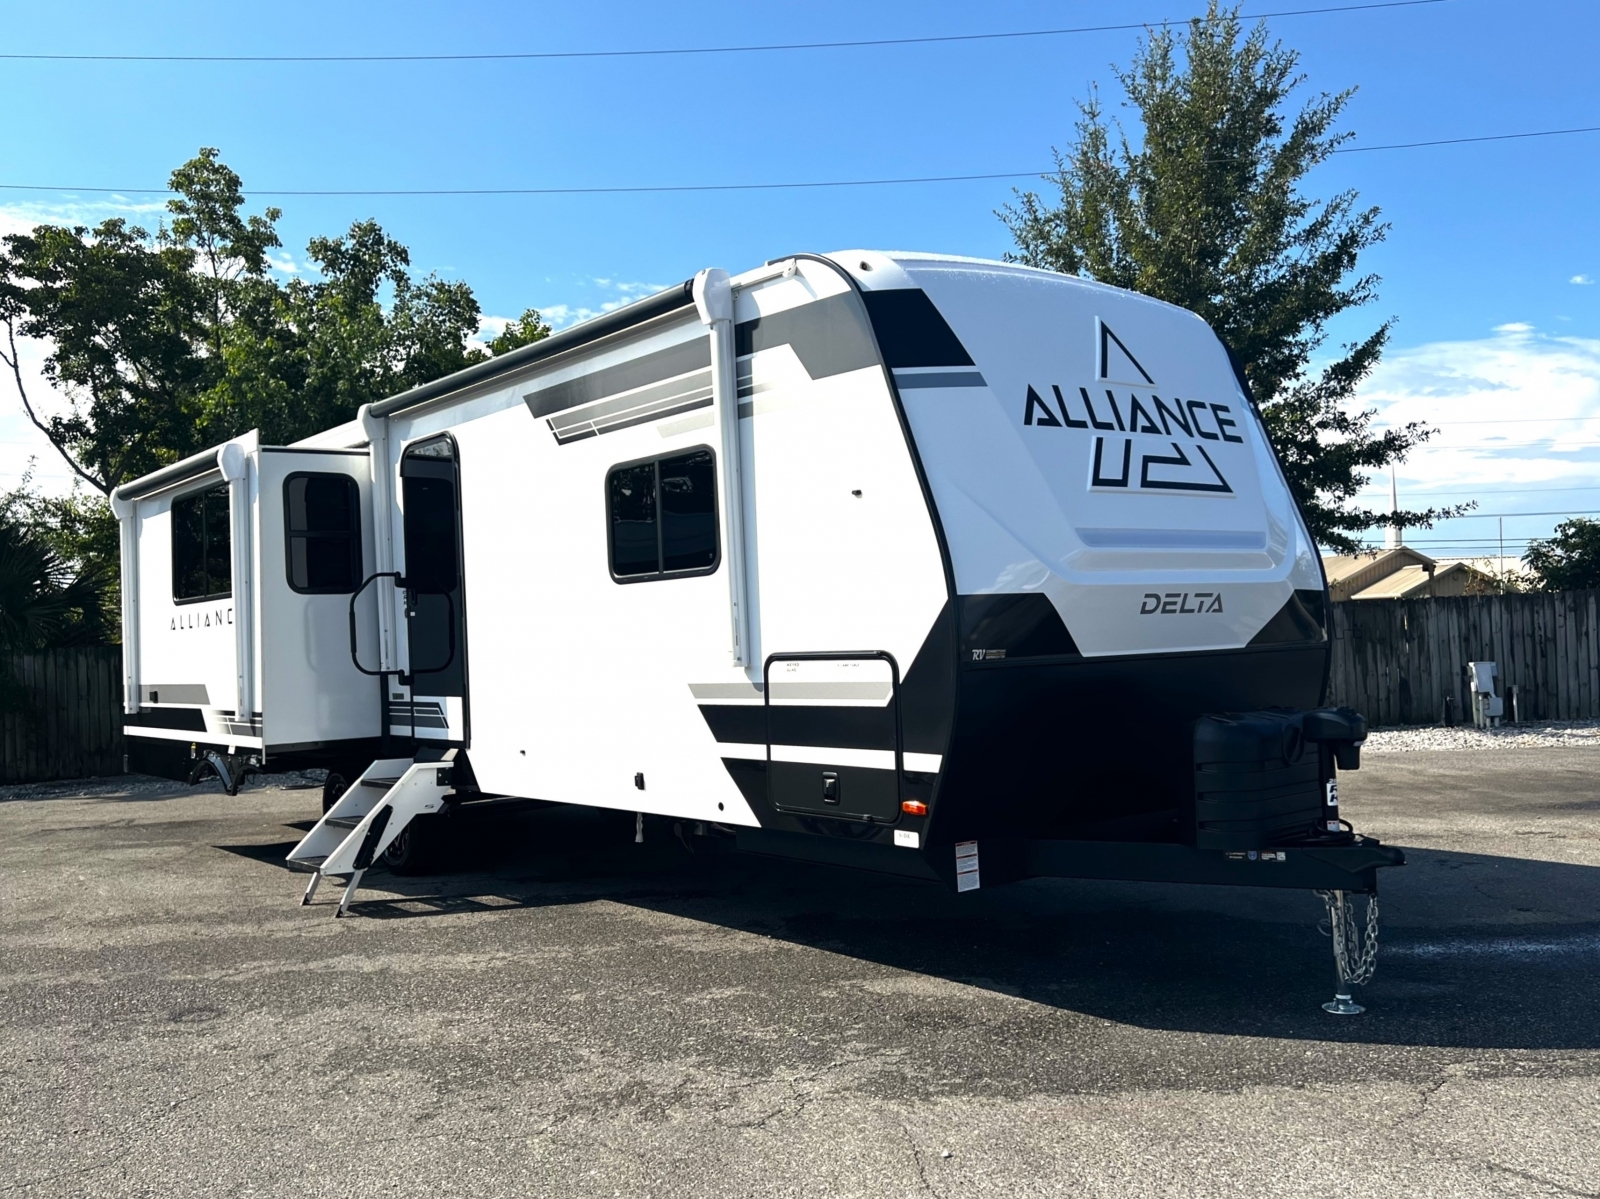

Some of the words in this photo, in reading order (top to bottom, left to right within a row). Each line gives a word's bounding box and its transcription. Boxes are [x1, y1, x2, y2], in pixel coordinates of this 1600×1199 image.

[1023, 383, 1244, 444] ALLIANCE
[1140, 592, 1224, 615] DELTA
[972, 649, 986, 661] RV
